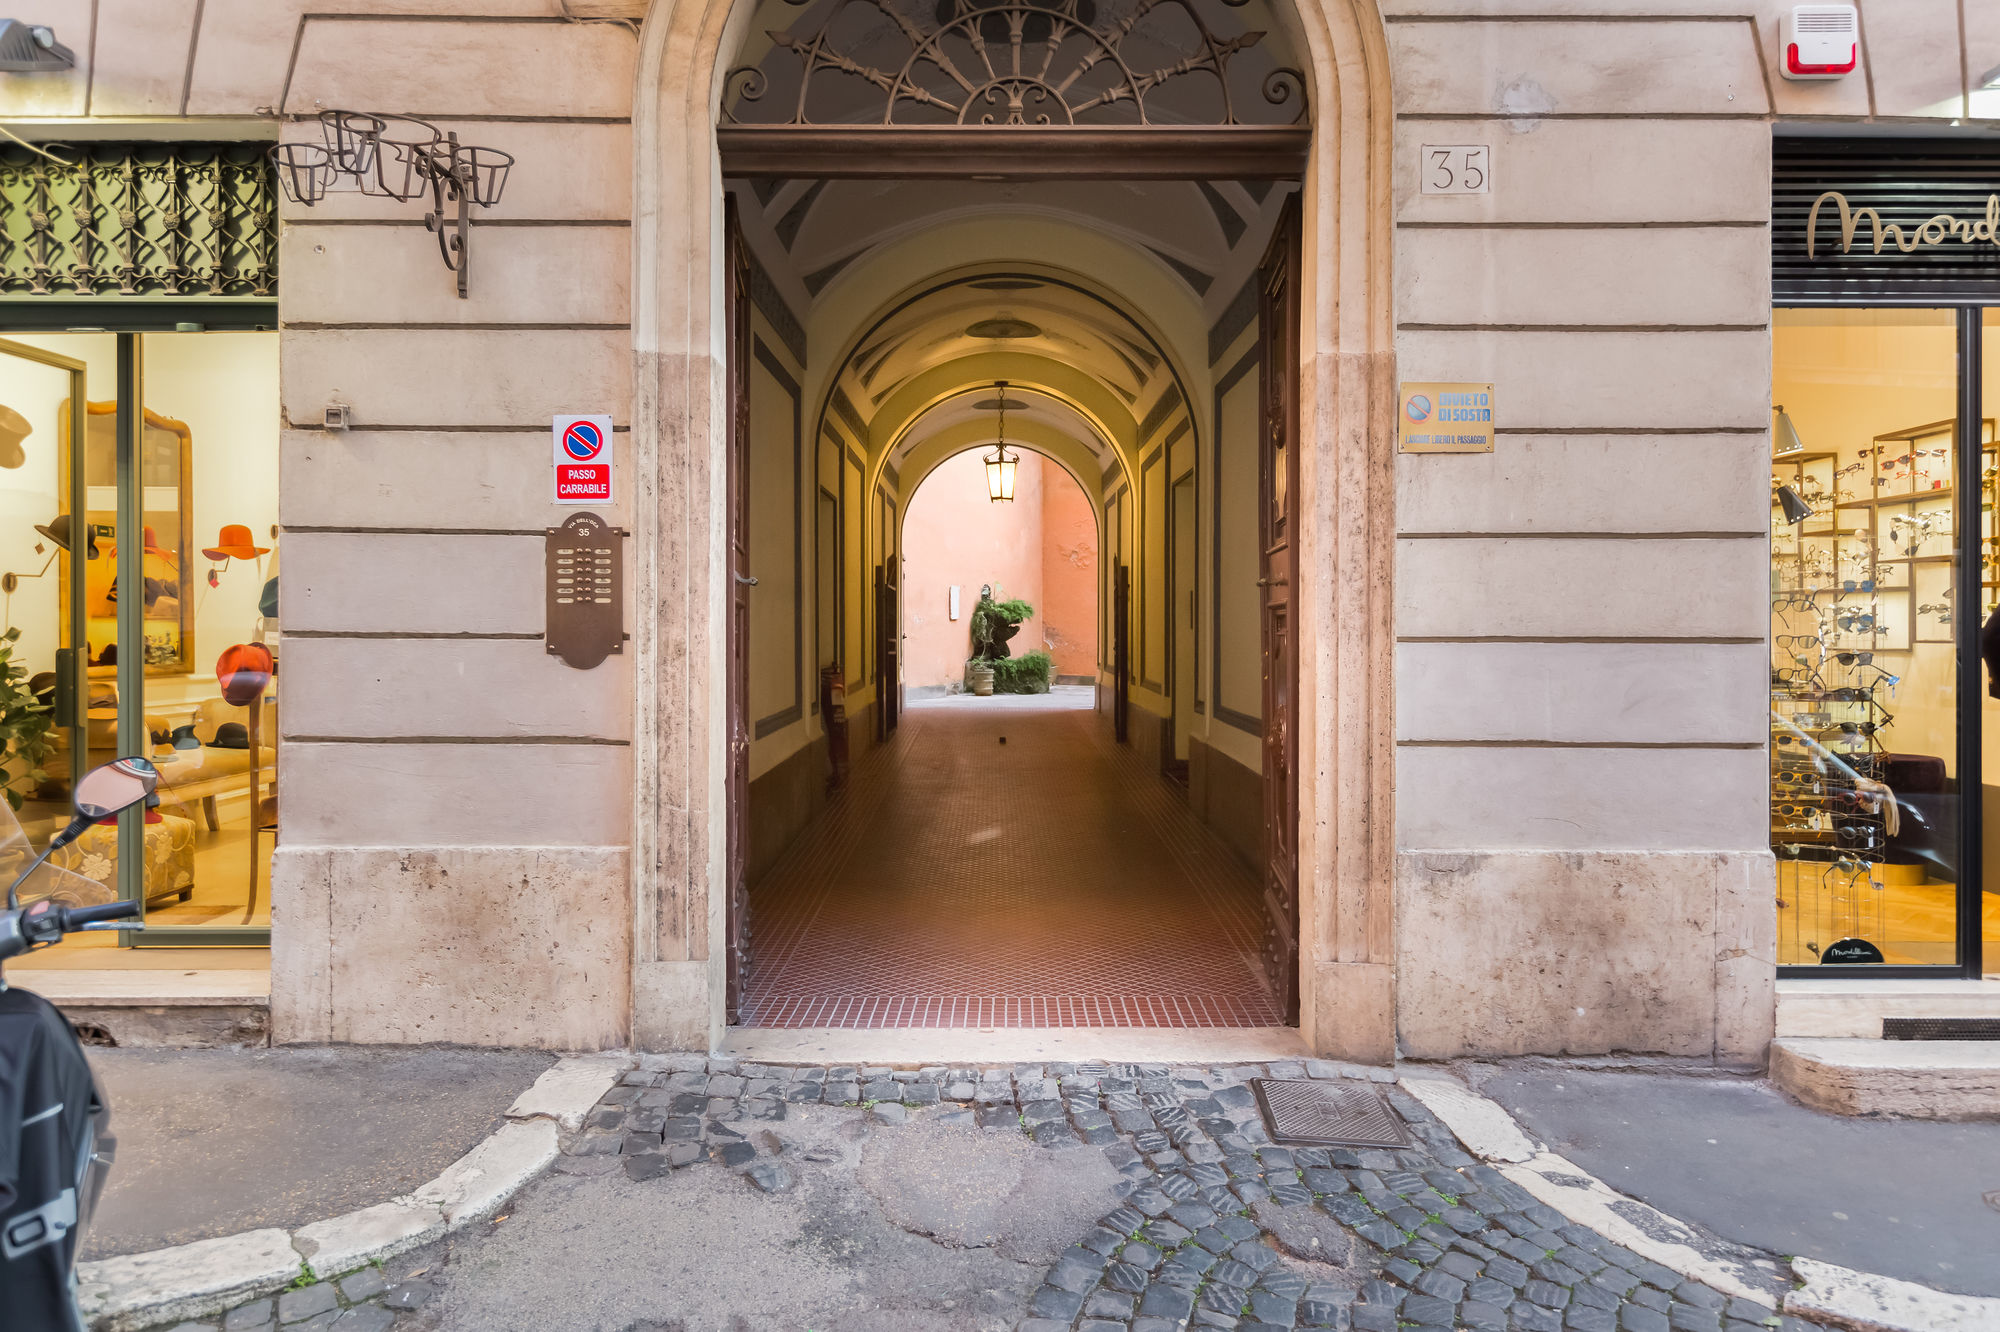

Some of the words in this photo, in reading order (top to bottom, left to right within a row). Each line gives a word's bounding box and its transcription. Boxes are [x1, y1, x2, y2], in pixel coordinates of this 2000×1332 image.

[1430, 150, 1484, 190] 35
[1439, 392, 1489, 407] DIVIETO
[1438, 408, 1451, 422] DI
[1453, 408, 1491, 422] SOSTA
[1431, 435, 1451, 445] LIBERO
[1457, 435, 1487, 445] PASSAGGIO
[568, 469, 596, 480] PASSO
[560, 484, 607, 494] CARRABILE
[568, 521, 576, 529] VIA
[578, 528, 590, 537] 35
